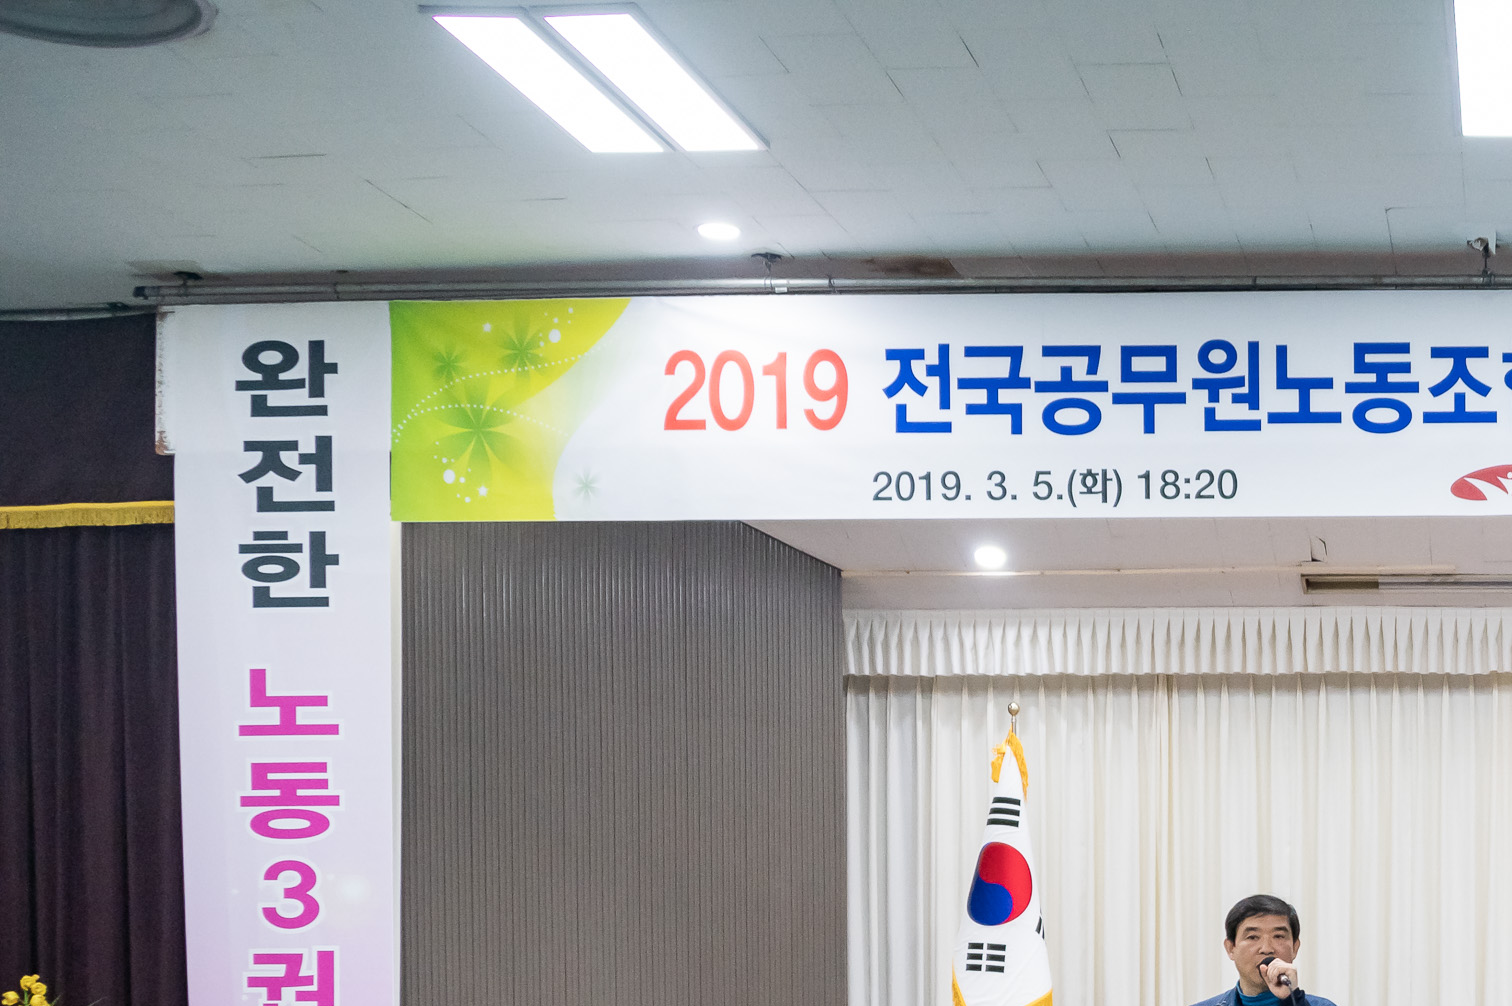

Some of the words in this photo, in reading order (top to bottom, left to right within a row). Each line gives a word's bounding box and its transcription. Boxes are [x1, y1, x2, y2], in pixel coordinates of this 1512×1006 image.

[663, 348, 849, 431] 2019
[235, 339, 340, 608] 완전한
[872, 471, 972, 501] 2019.
[985, 471, 1018, 501] 3.
[1032, 469, 1123, 507] 5.(화)
[1137, 469, 1239, 500] 18:20
